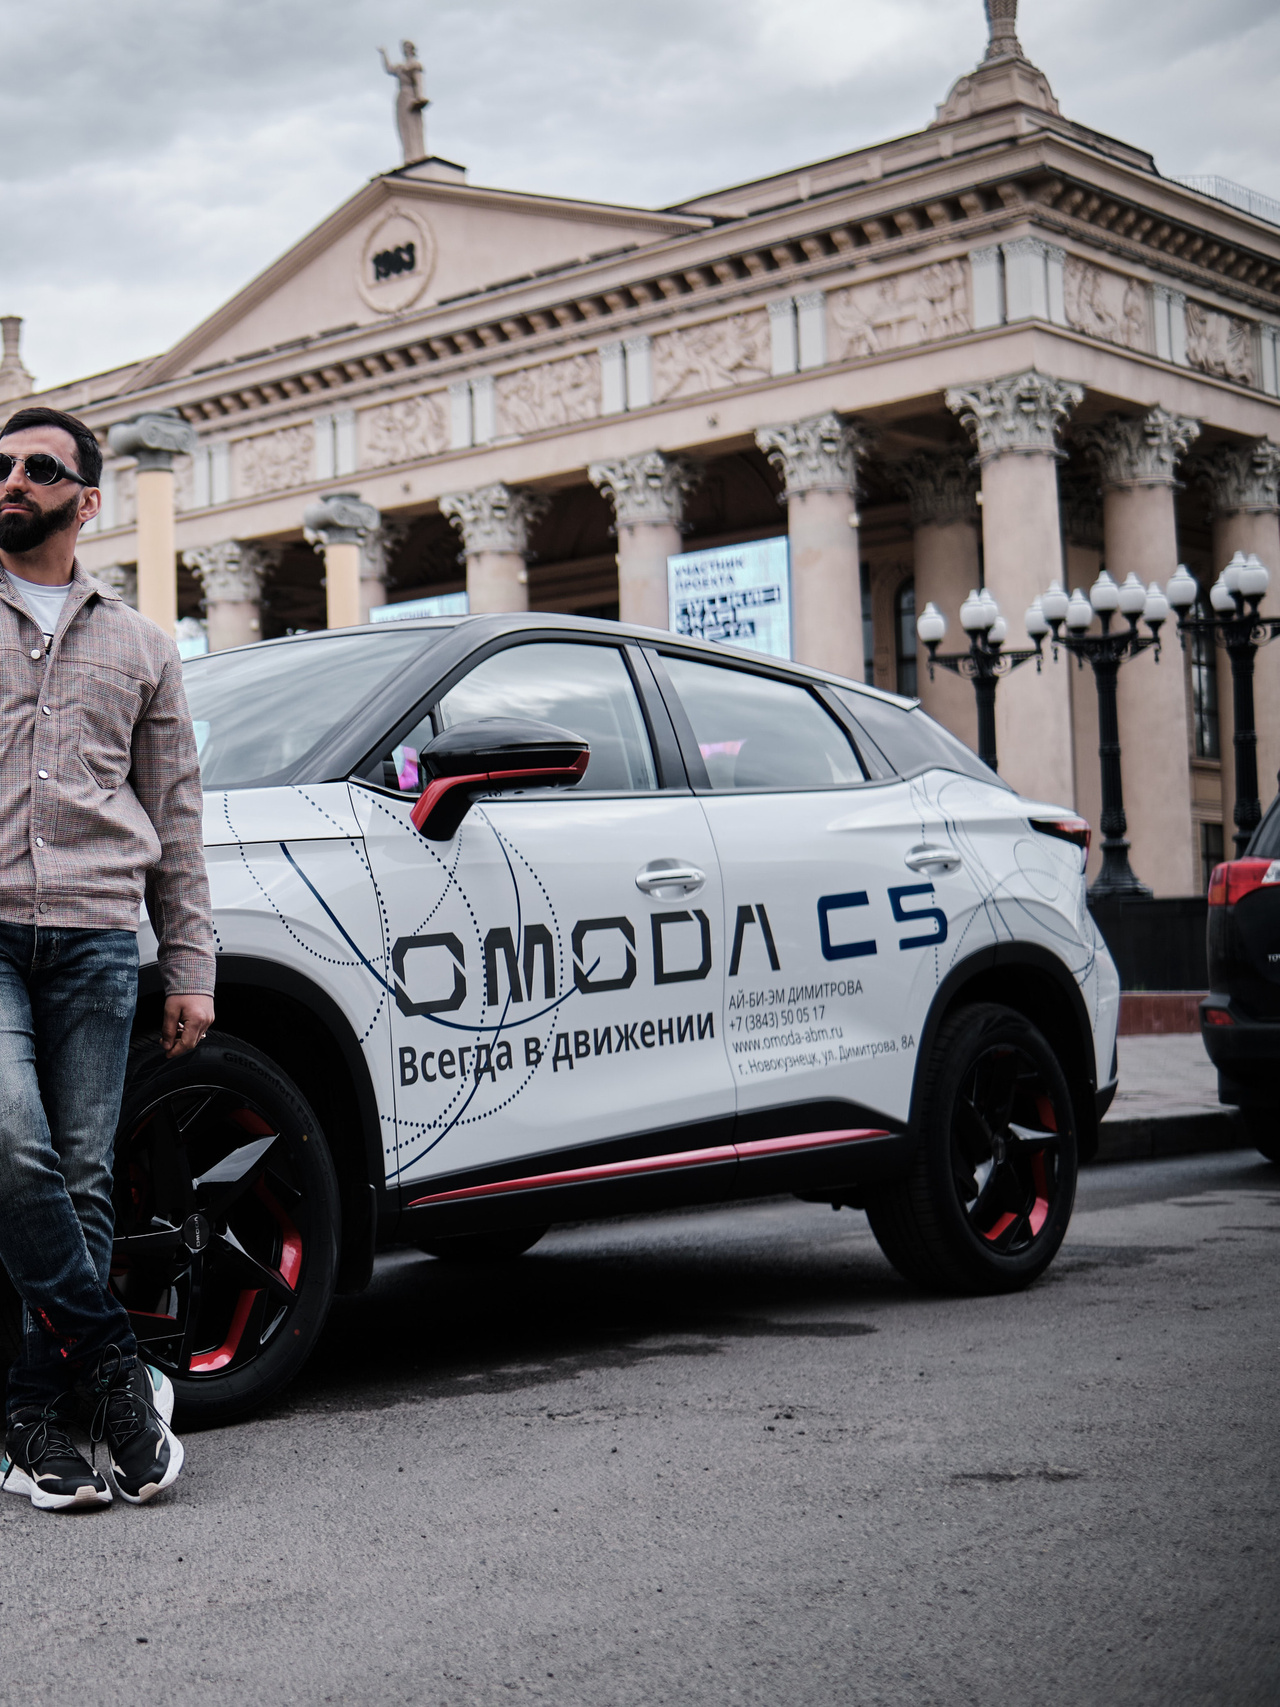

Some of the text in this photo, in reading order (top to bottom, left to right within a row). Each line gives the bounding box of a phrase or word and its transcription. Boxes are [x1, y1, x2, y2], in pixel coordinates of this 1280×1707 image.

[675, 574, 735, 591] ПРОЕКТА
[391, 883, 949, 1018] OMODA C5
[729, 979, 863, 1010] АЙ-БИ-ЭМ ДИМИТРОВА
[729, 1004, 825, 1033] +7 (3843) 50 05 17
[398, 1012, 715, 1086] Всегда в движении
[732, 1026, 843, 1053] www.omoda-abm.ru
[738, 1063, 748, 1075] г.
[748, 1052, 821, 1072] Новокузнецк,
[822, 1049, 837, 1066] ул.
[838, 1039, 899, 1063] Димитрова,
[223, 1052, 295, 1104] GitiComfort
